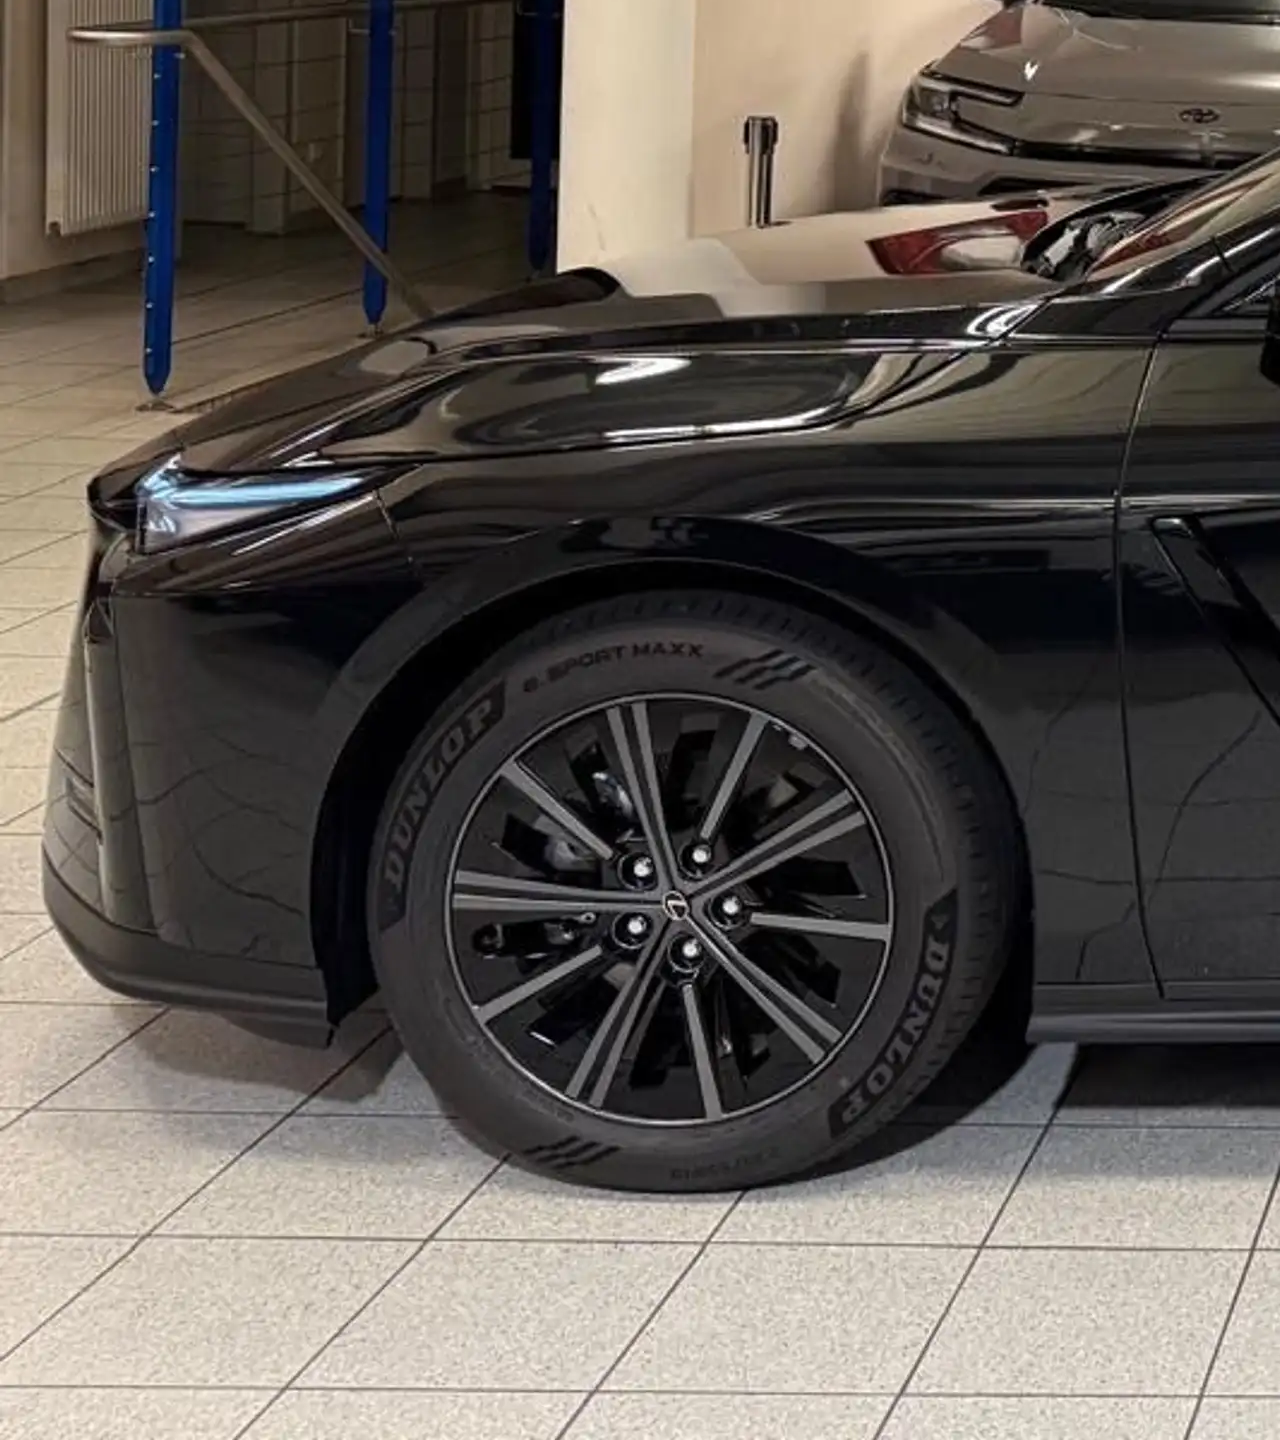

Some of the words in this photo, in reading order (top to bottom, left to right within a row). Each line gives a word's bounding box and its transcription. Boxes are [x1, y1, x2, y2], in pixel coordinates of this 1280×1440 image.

[632, 641, 704, 658] MAXX
[385, 698, 492, 893] DUNLOP
[841, 933, 950, 1125] DUNLOP
